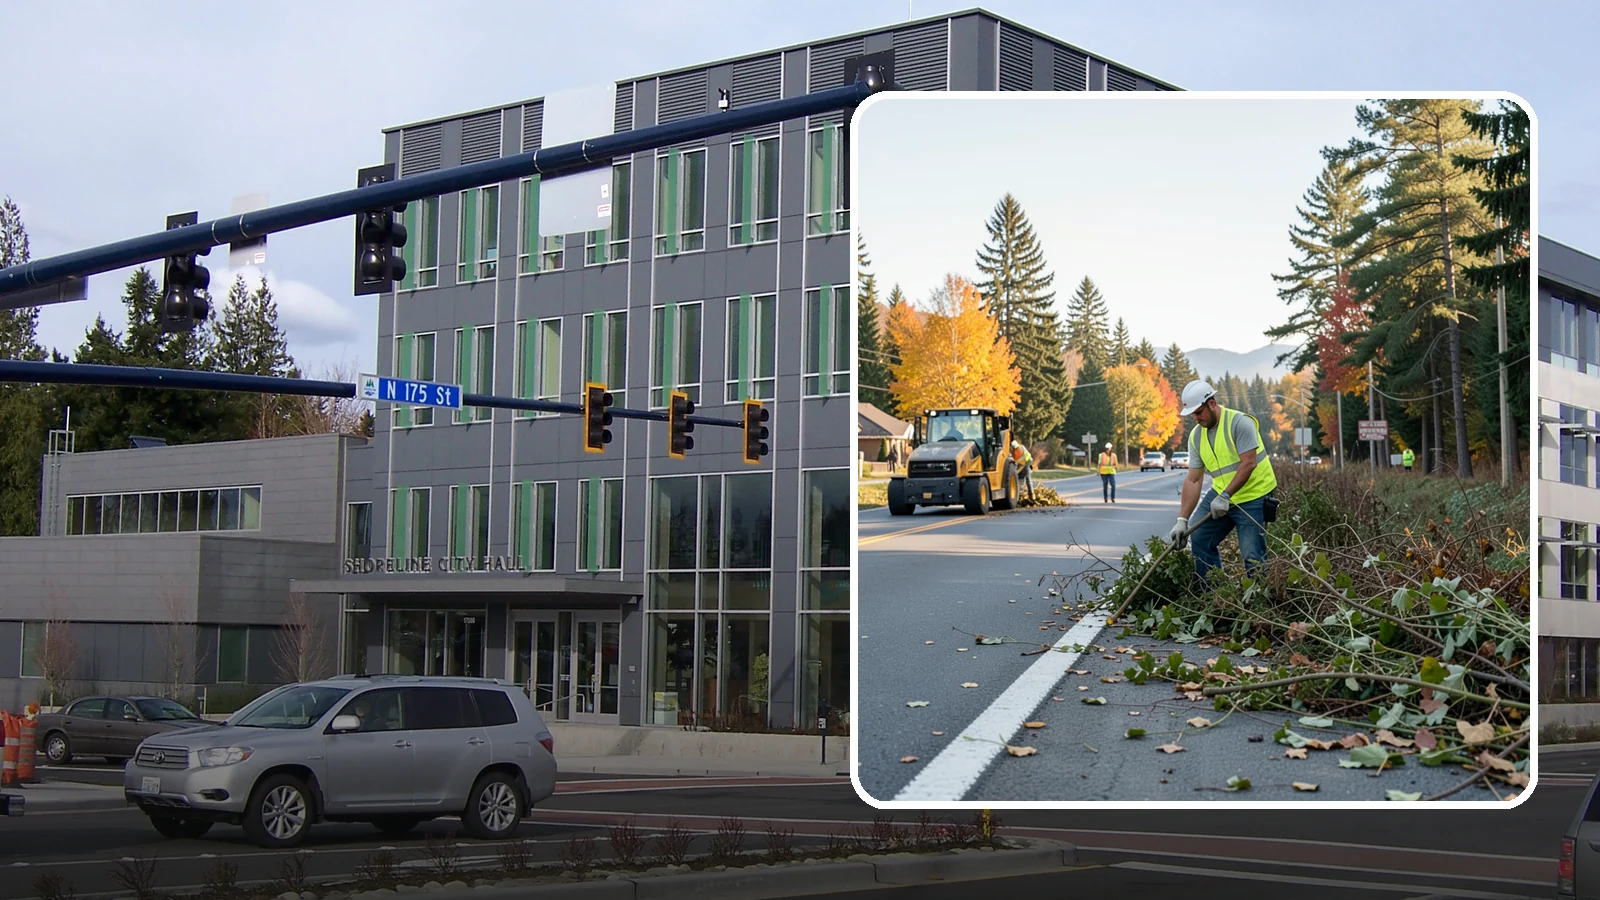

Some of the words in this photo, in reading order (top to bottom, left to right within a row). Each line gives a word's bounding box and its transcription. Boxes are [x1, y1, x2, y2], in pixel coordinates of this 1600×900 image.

[387, 380, 396, 400] N
[405, 382, 427, 403] 175
[436, 386, 452, 406] St
[344, 557, 432, 574] SHORELINE
[438, 556, 475, 573] CITY
[483, 555, 525, 572] HALL
